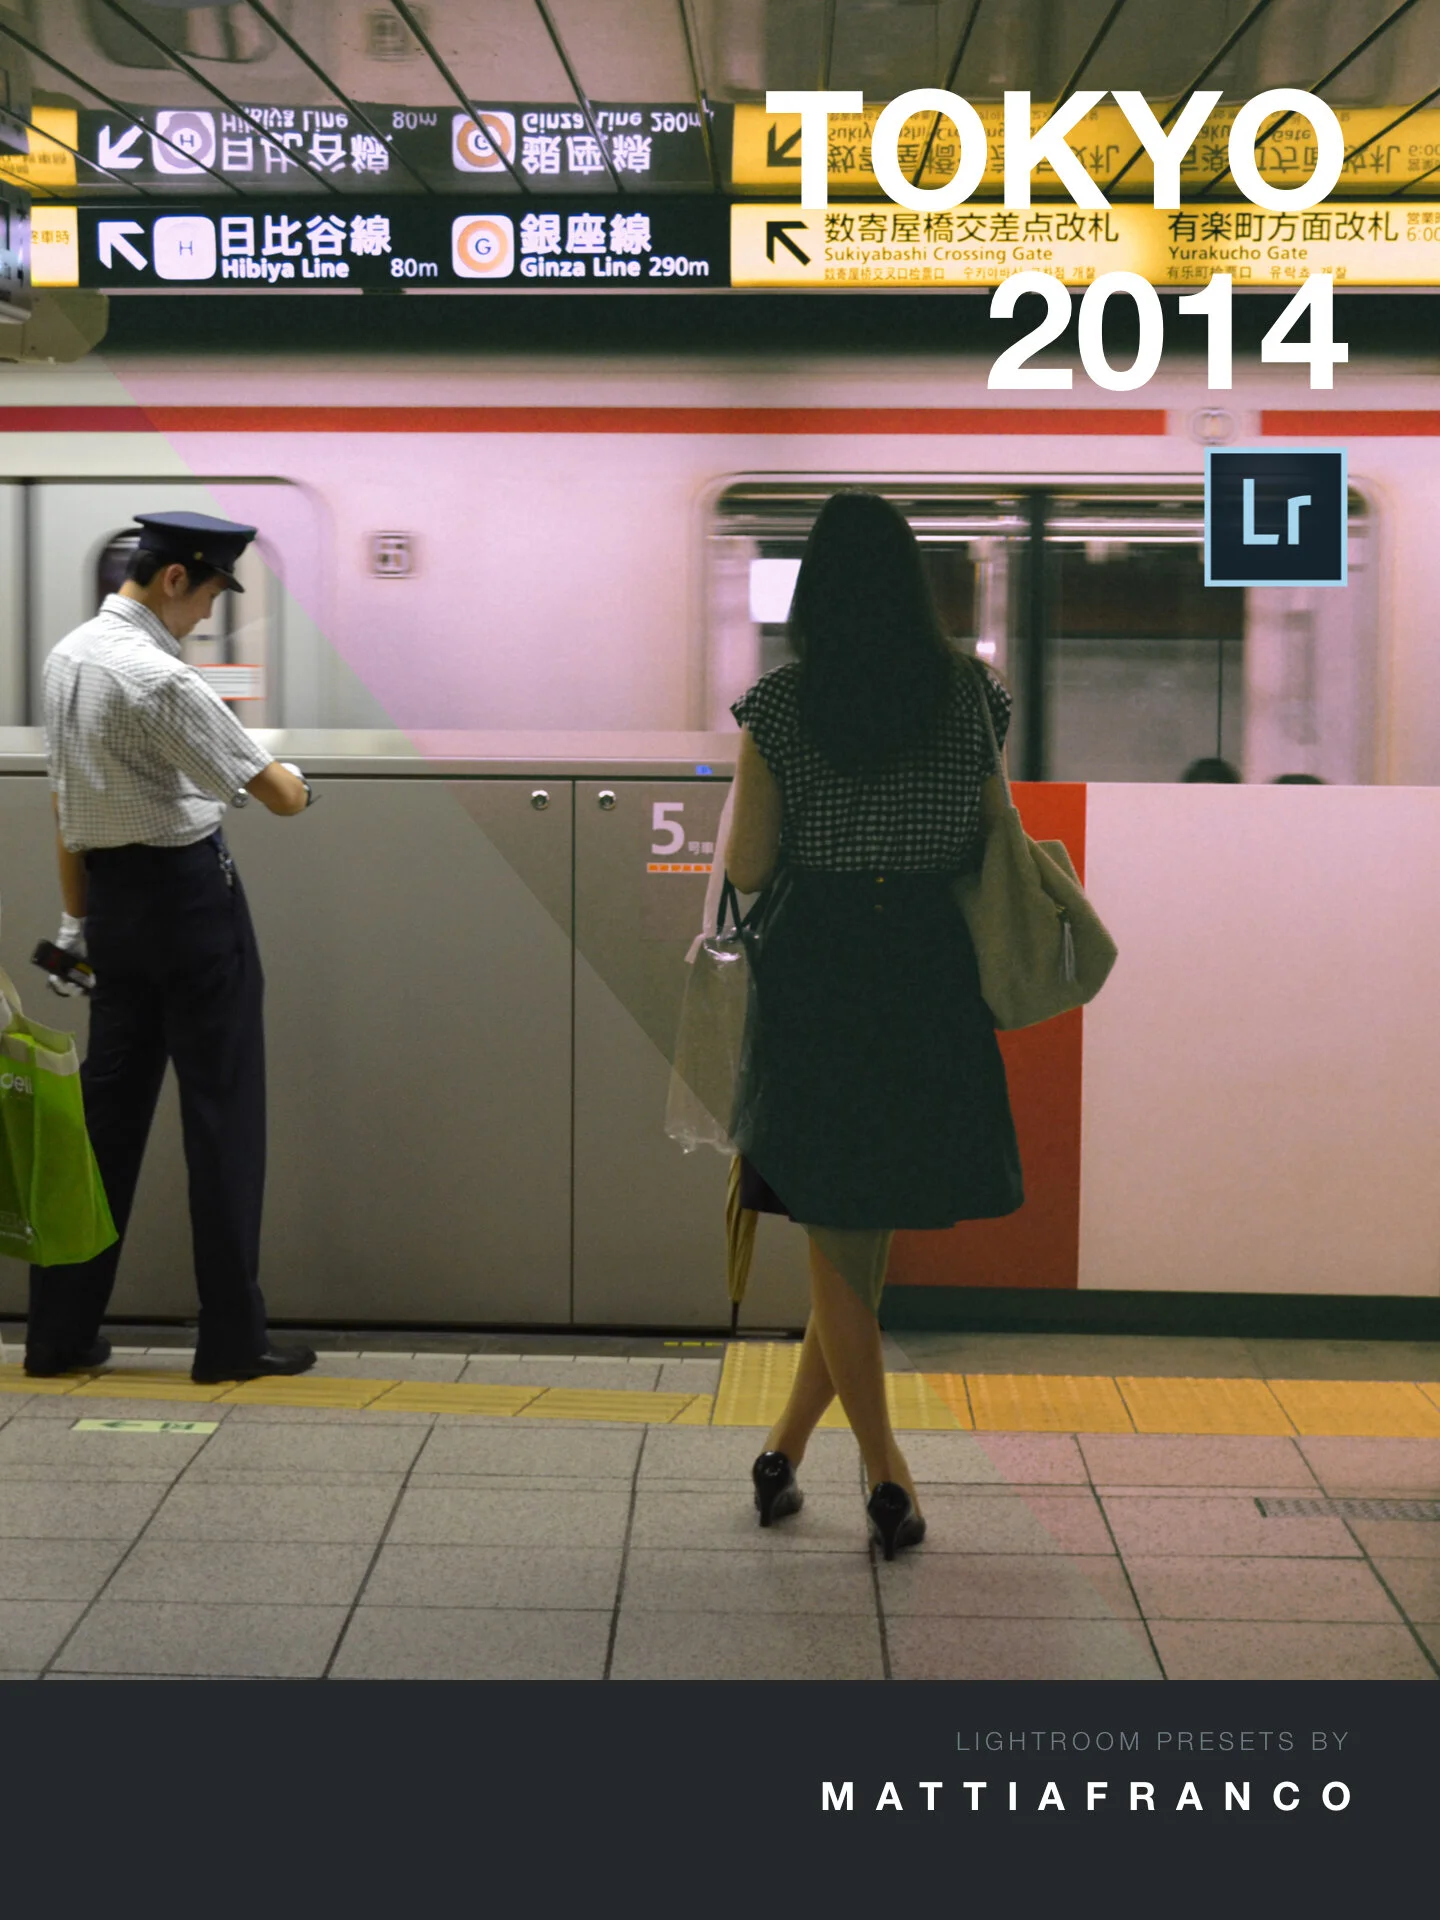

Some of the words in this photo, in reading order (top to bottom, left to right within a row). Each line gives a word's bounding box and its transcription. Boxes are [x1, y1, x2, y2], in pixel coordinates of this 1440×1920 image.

[220, 214, 392, 257] 日比谷線
[520, 213, 652, 254] 銀座線
[824, 212, 1119, 243] 数寄屋橋交差点改札
[1168, 211, 1398, 242] 有楽町方面改札
[178, 240, 193, 256] H
[474, 237, 492, 255] G
[824, 247, 927, 264] Sukiyabashi
[933, 246, 1006, 264] Crossing
[1012, 246, 1053, 260] Gate
[1168, 245, 1261, 260] Yurakucho
[1267, 245, 1308, 260] Gate
[222, 258, 295, 283] Hibiya
[302, 258, 350, 278] Line
[390, 258, 438, 278] 80m
[520, 256, 585, 277] Ginza
[593, 256, 641, 277] Line
[649, 256, 709, 277] 290m
